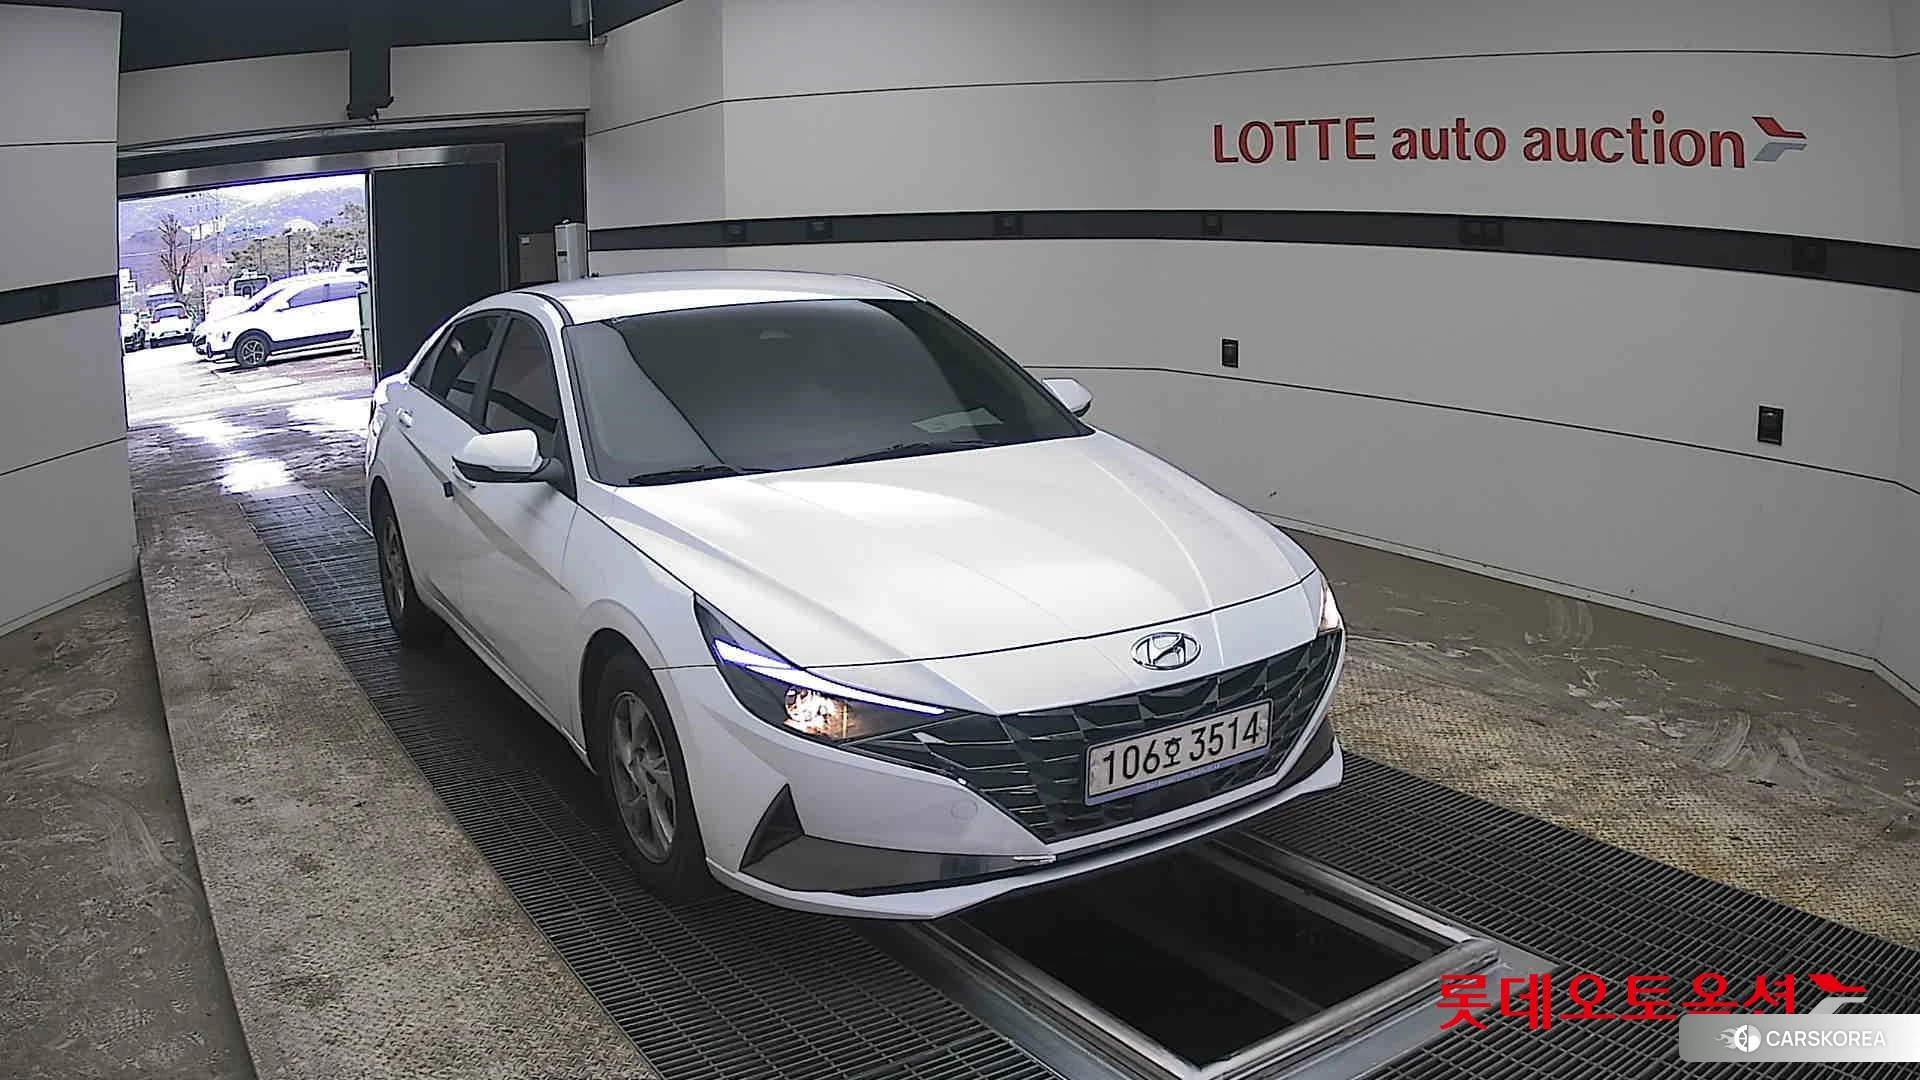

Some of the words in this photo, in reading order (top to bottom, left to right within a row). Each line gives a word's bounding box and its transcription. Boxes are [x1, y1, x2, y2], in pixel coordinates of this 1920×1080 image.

[1213, 116, 1376, 164] LOTTE
[1391, 116, 1507, 162] auto
[1522, 109, 1746, 169] auction
